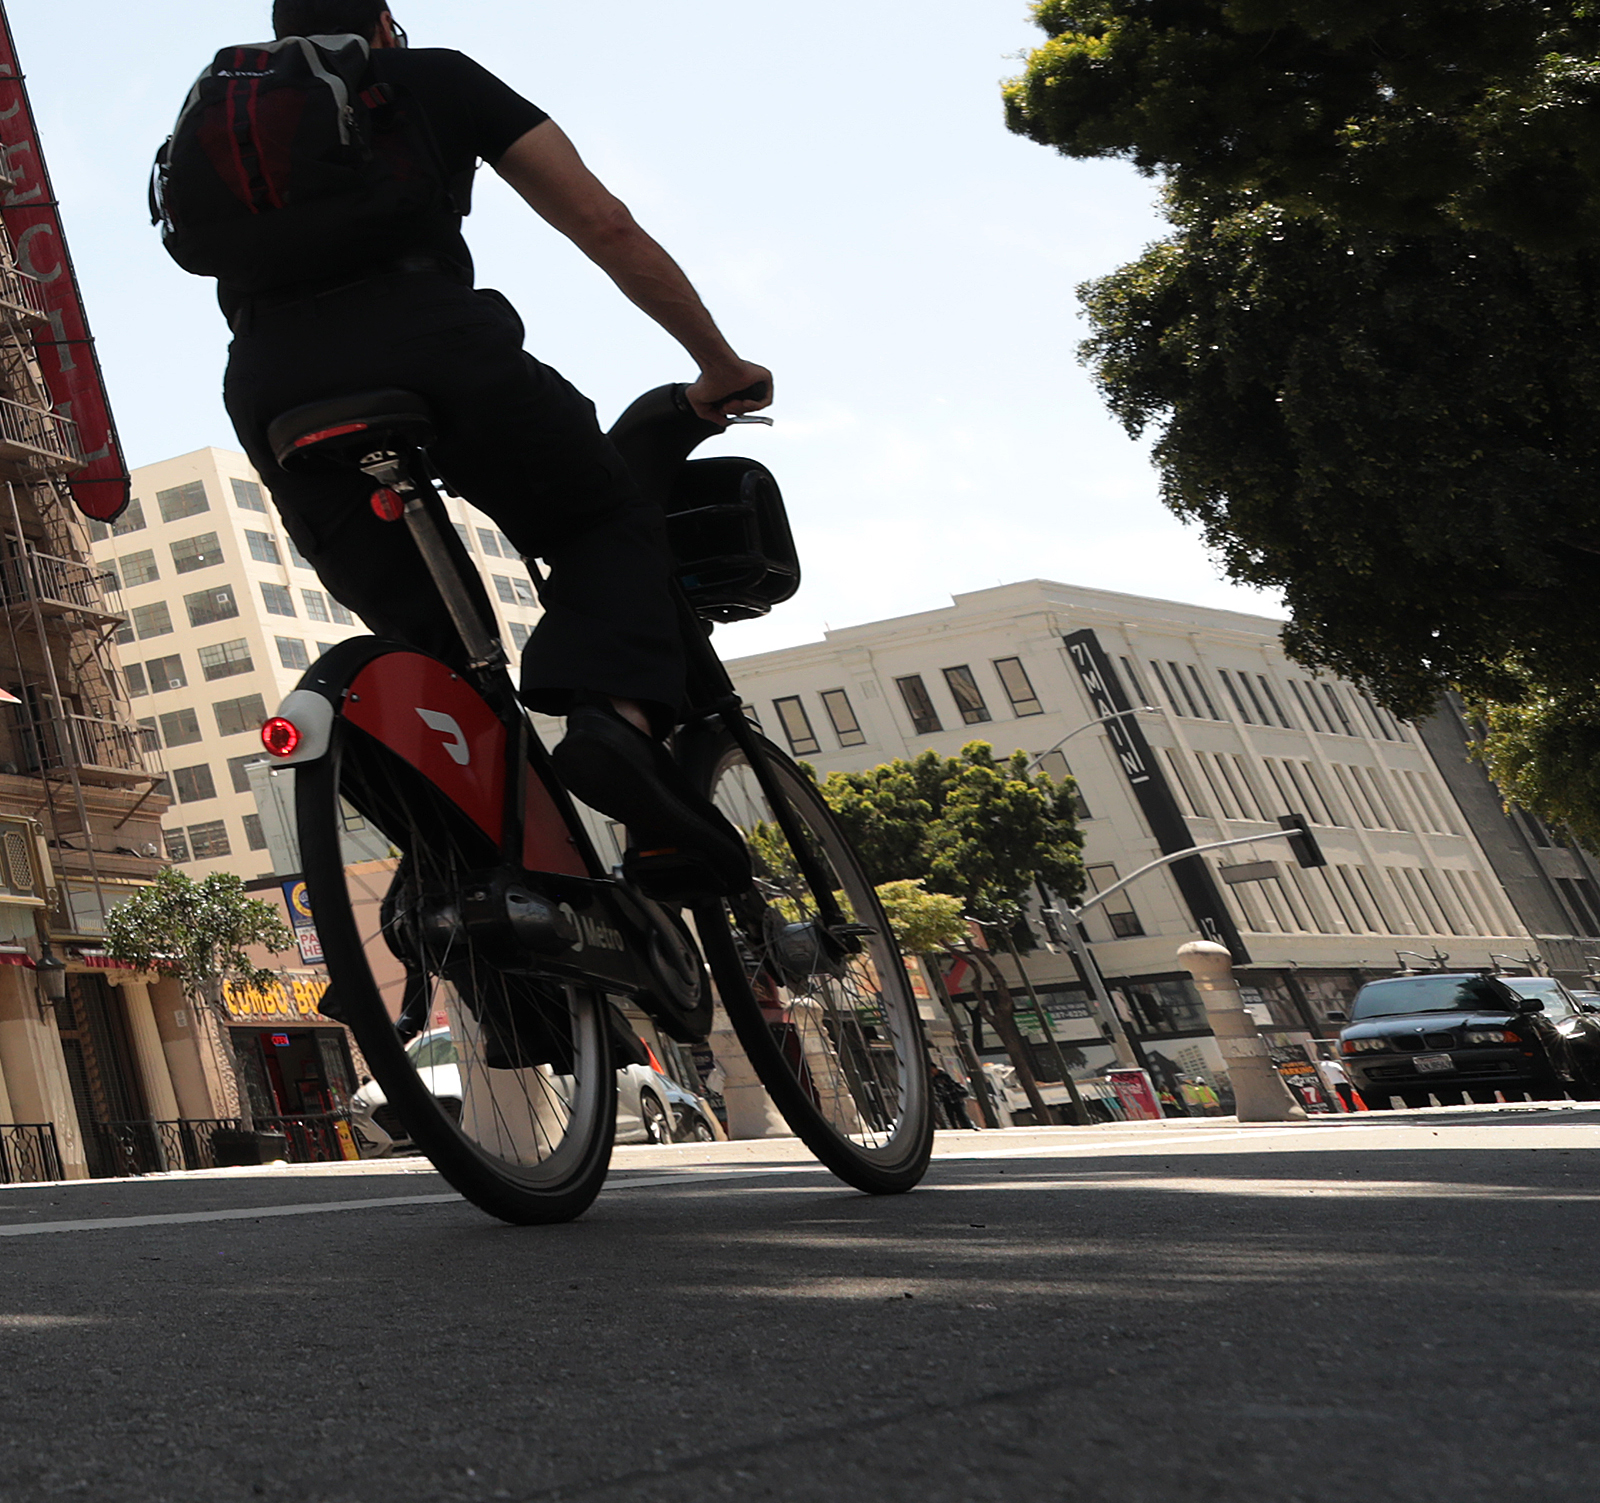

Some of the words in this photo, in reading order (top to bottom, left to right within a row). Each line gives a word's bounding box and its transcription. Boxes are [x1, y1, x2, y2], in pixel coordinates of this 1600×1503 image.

[1081, 670, 1141, 775] MAIN
[300, 933, 319, 945] PA
[580, 915, 625, 952] Metro
[1279, 1066, 1316, 1075] PARKING
